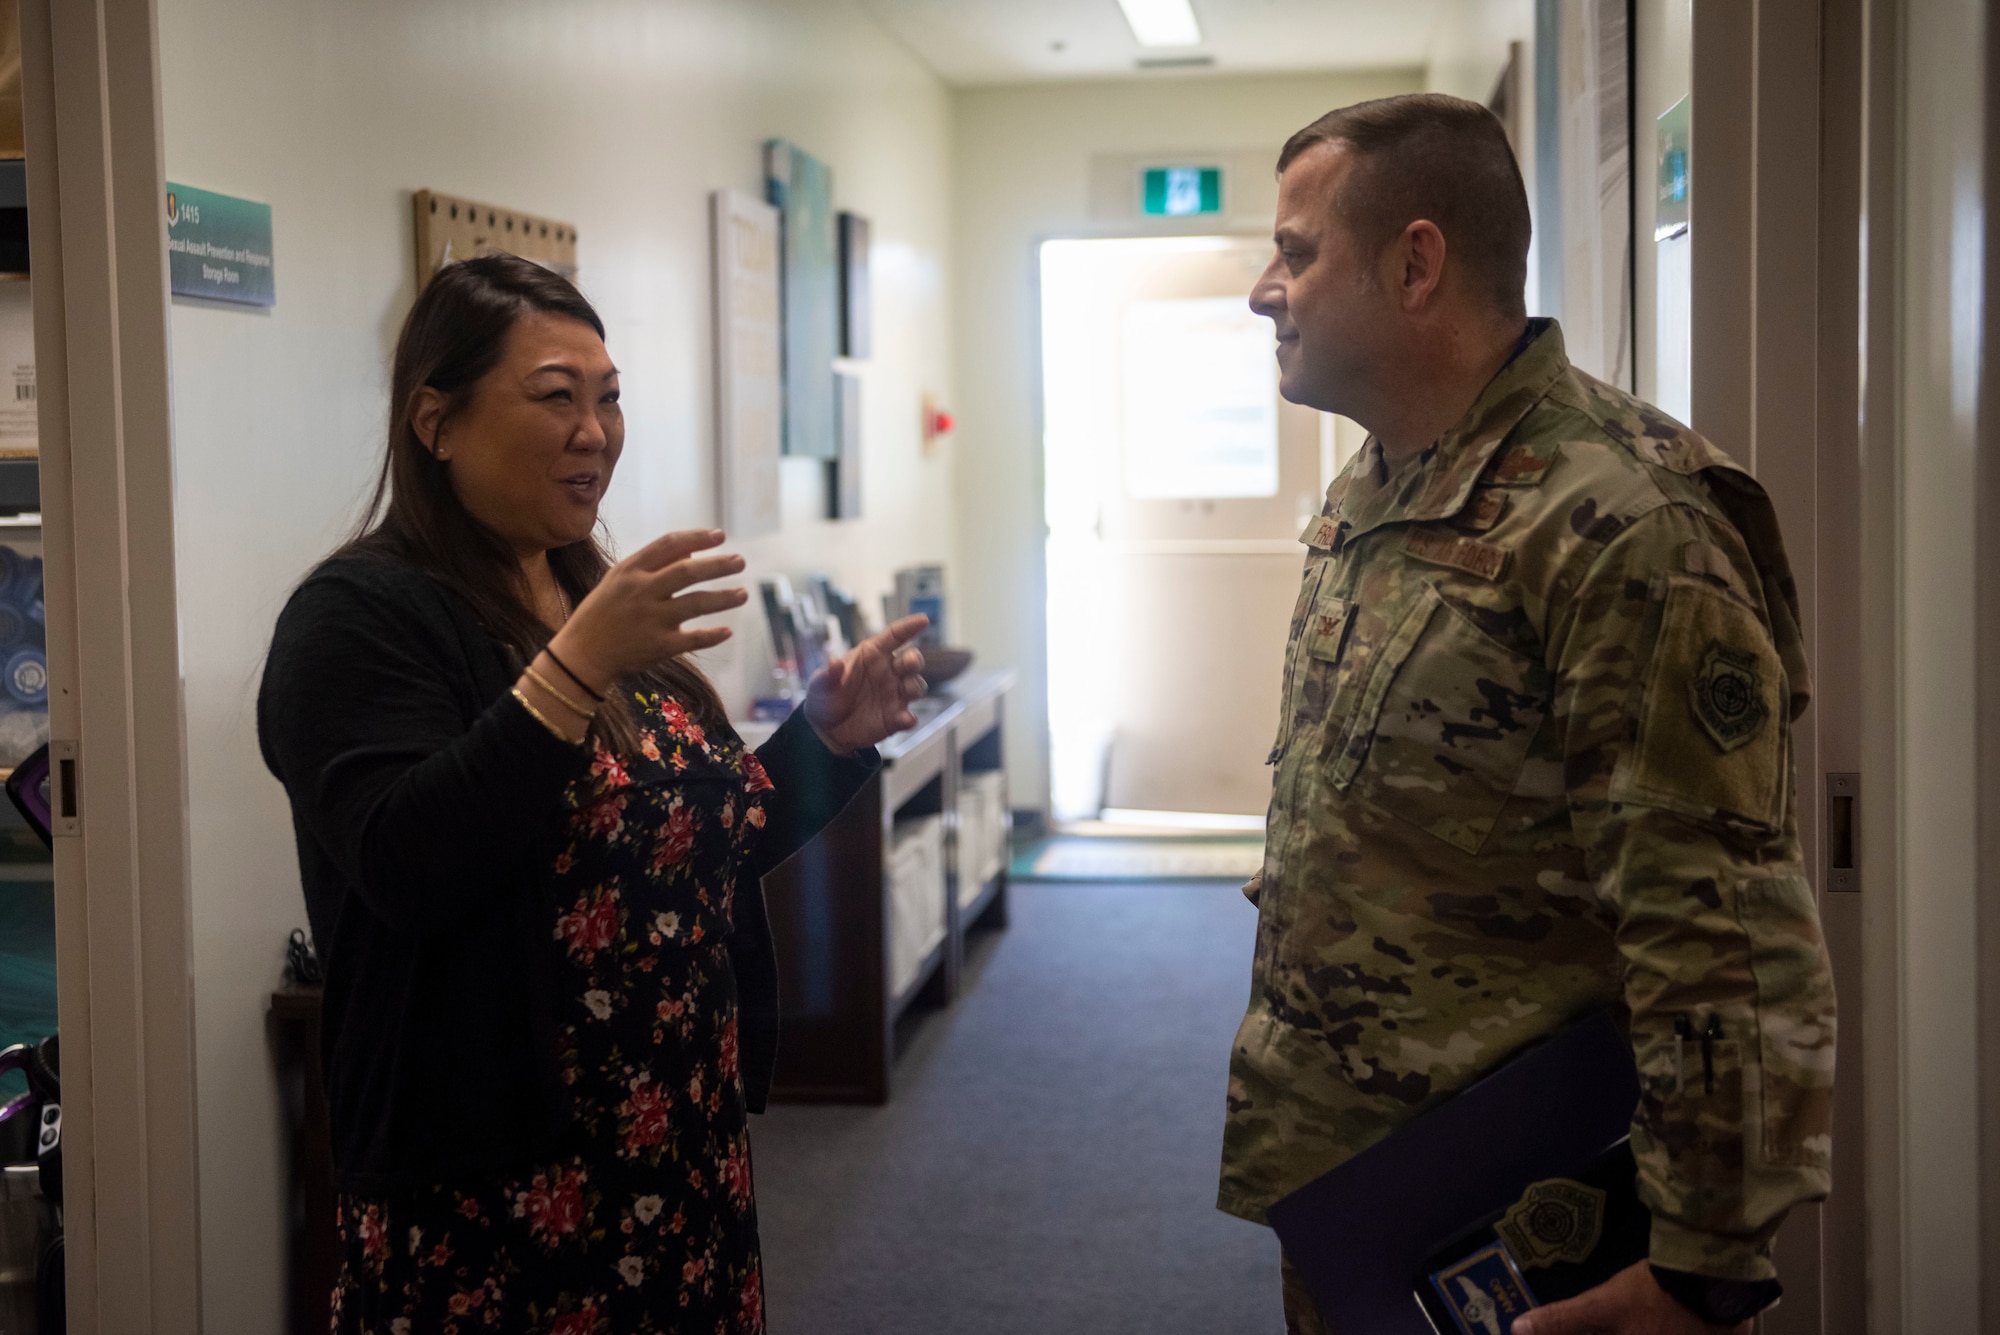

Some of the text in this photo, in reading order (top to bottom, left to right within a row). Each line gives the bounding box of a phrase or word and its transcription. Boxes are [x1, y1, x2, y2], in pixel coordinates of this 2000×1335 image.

[181, 203, 200, 224] 1415
[186, 238, 206, 257] Assault
[207, 241, 235, 261] Prevention
[236, 247, 245, 263] and
[202, 263, 240, 284] Storage Room
